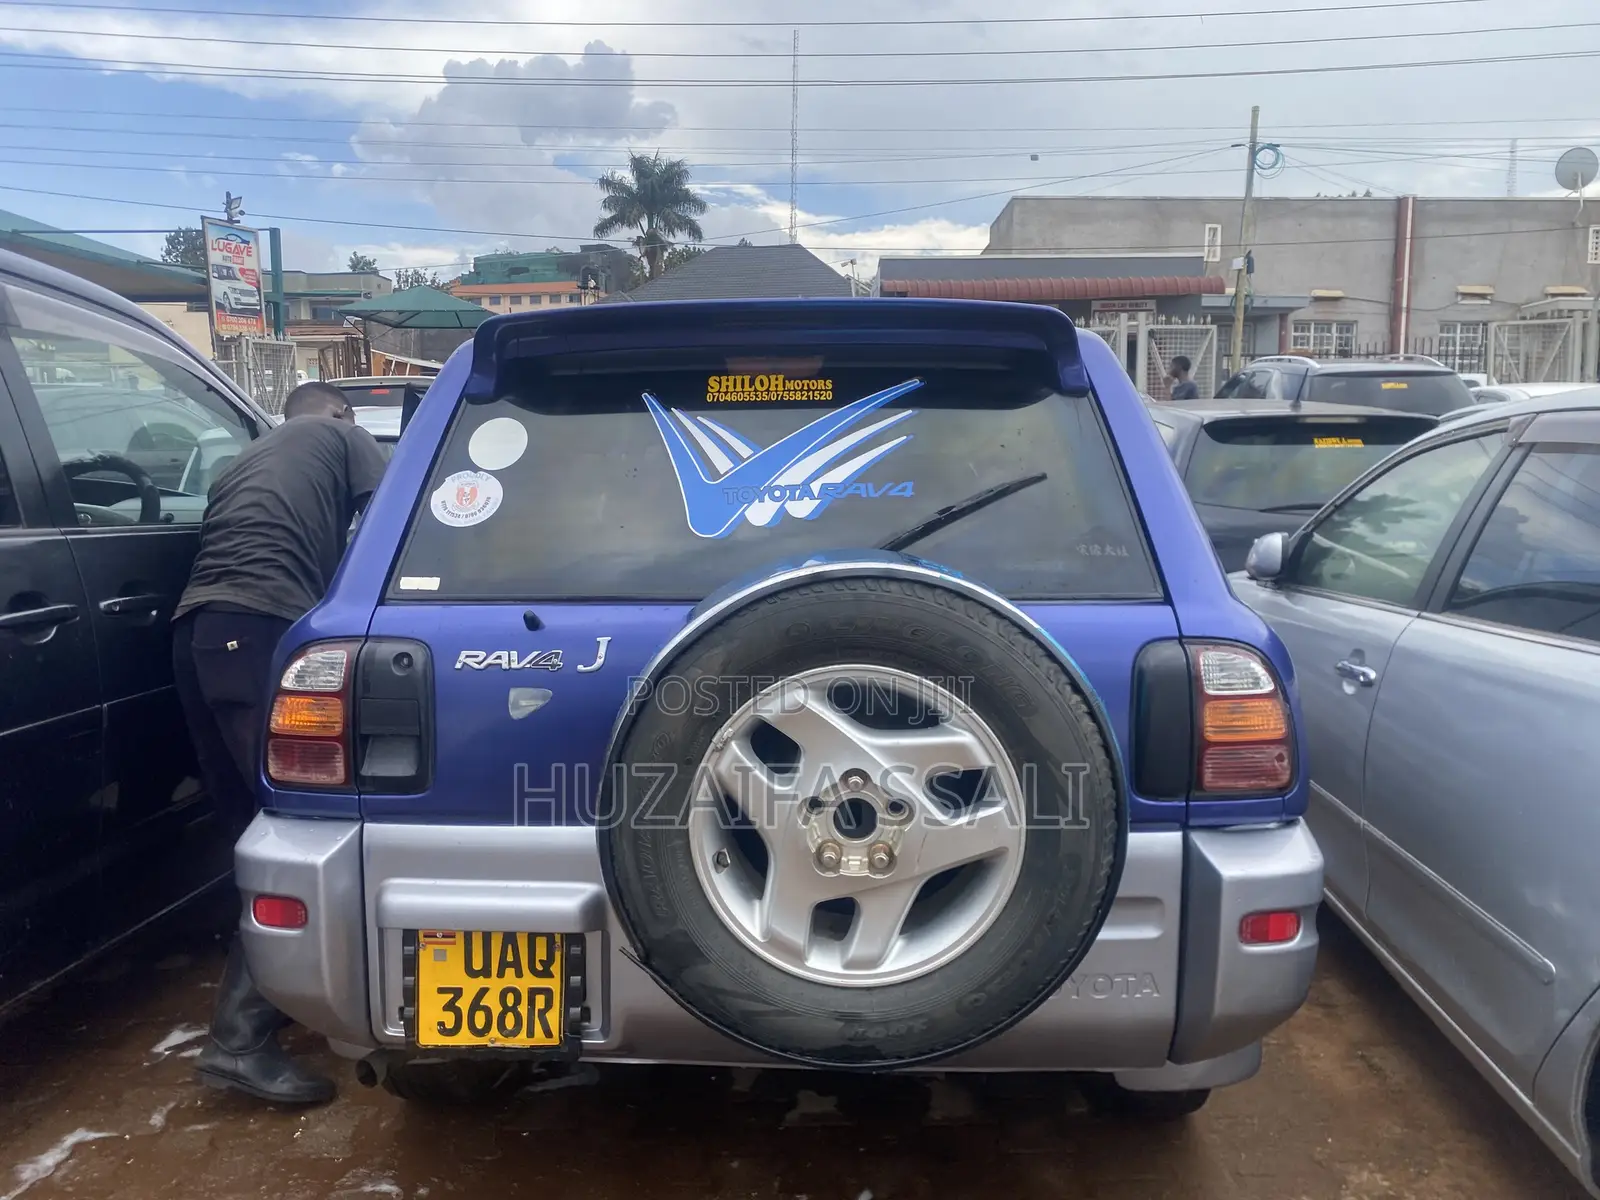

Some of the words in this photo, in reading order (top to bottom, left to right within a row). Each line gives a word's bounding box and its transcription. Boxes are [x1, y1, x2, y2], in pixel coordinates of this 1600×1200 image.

[211, 239, 252, 257] LUGAVE
[708, 375, 784, 392] SHILOH
[785, 380, 832, 390] MOTORS
[707, 391, 832, 402] 0704605535/0755821520
[722, 484, 816, 505] TOYOTA
[817, 482, 916, 501] RAV4
[454, 650, 563, 671] RAV4
[576, 636, 612, 673] J
[463, 931, 556, 979] UAQ
[1054, 972, 1160, 1000] YOTA
[436, 986, 555, 1039] 368R
